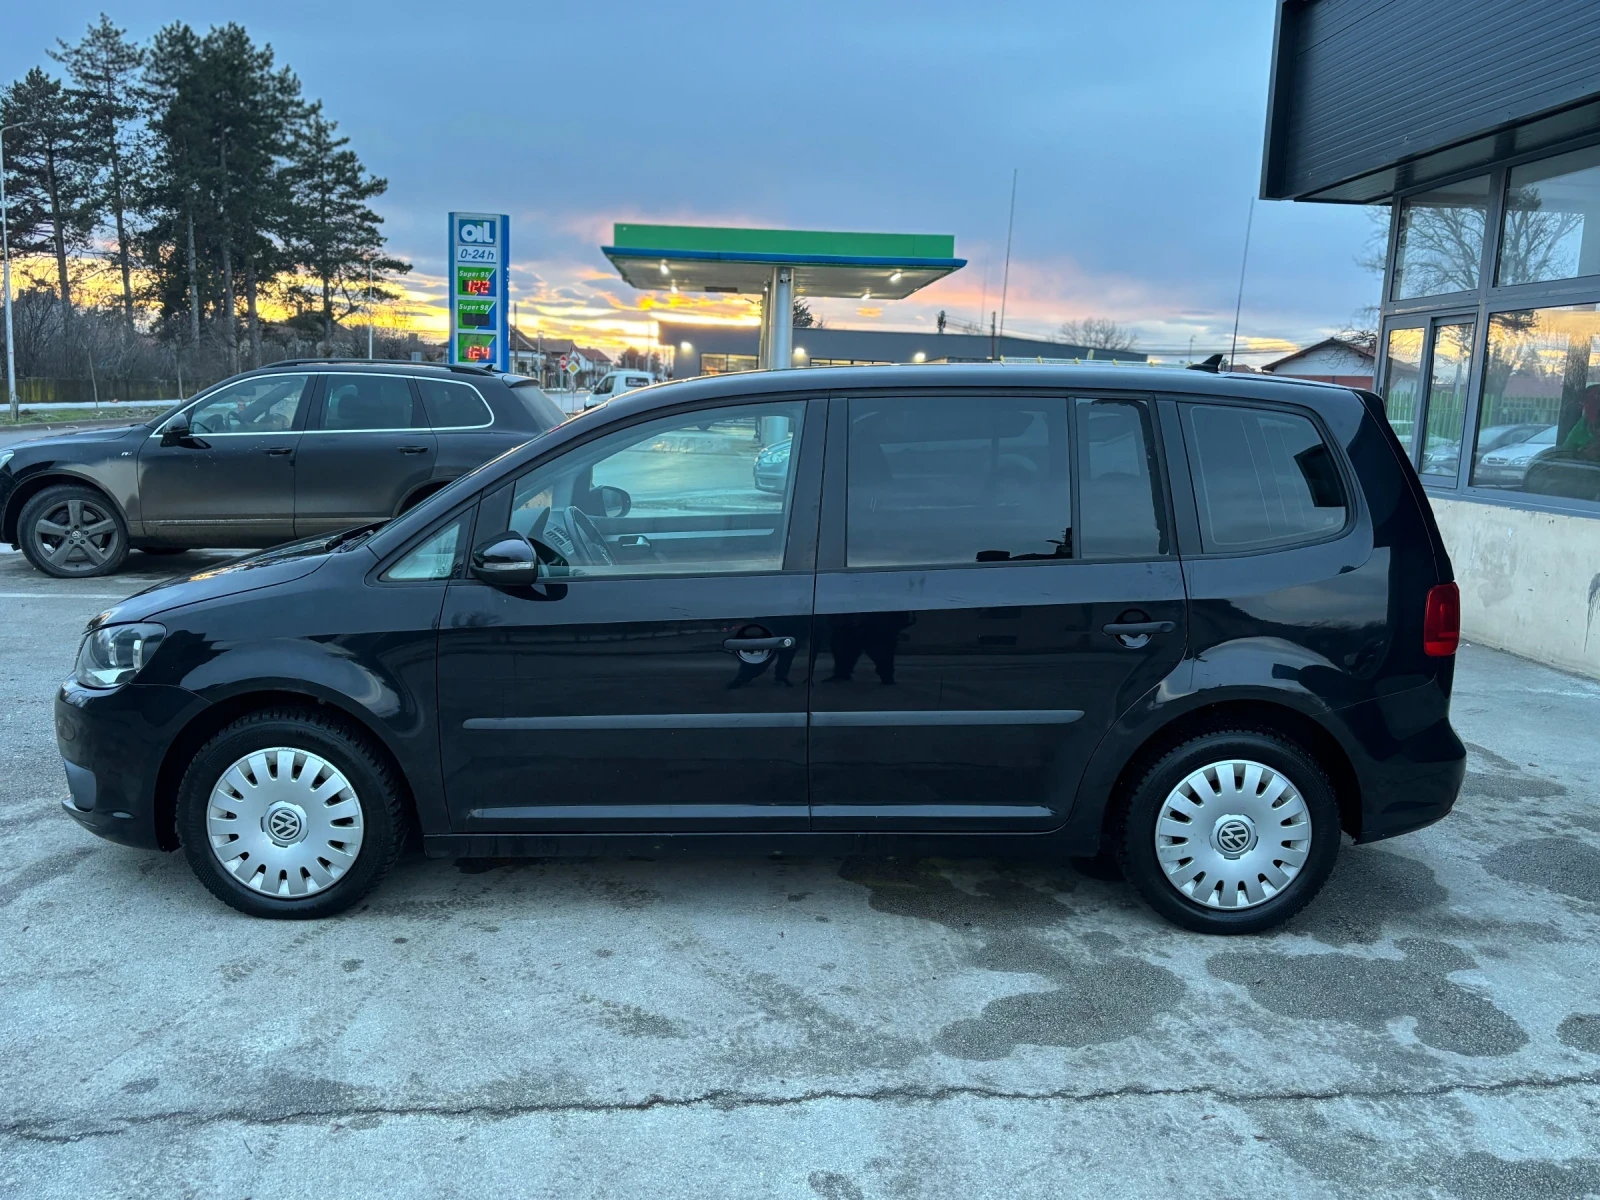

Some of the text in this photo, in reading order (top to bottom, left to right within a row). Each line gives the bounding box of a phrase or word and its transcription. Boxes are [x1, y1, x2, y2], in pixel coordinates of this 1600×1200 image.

[460, 248, 495, 260] 0-24 h
[459, 270, 480, 279] Super
[459, 303, 479, 311] Super
